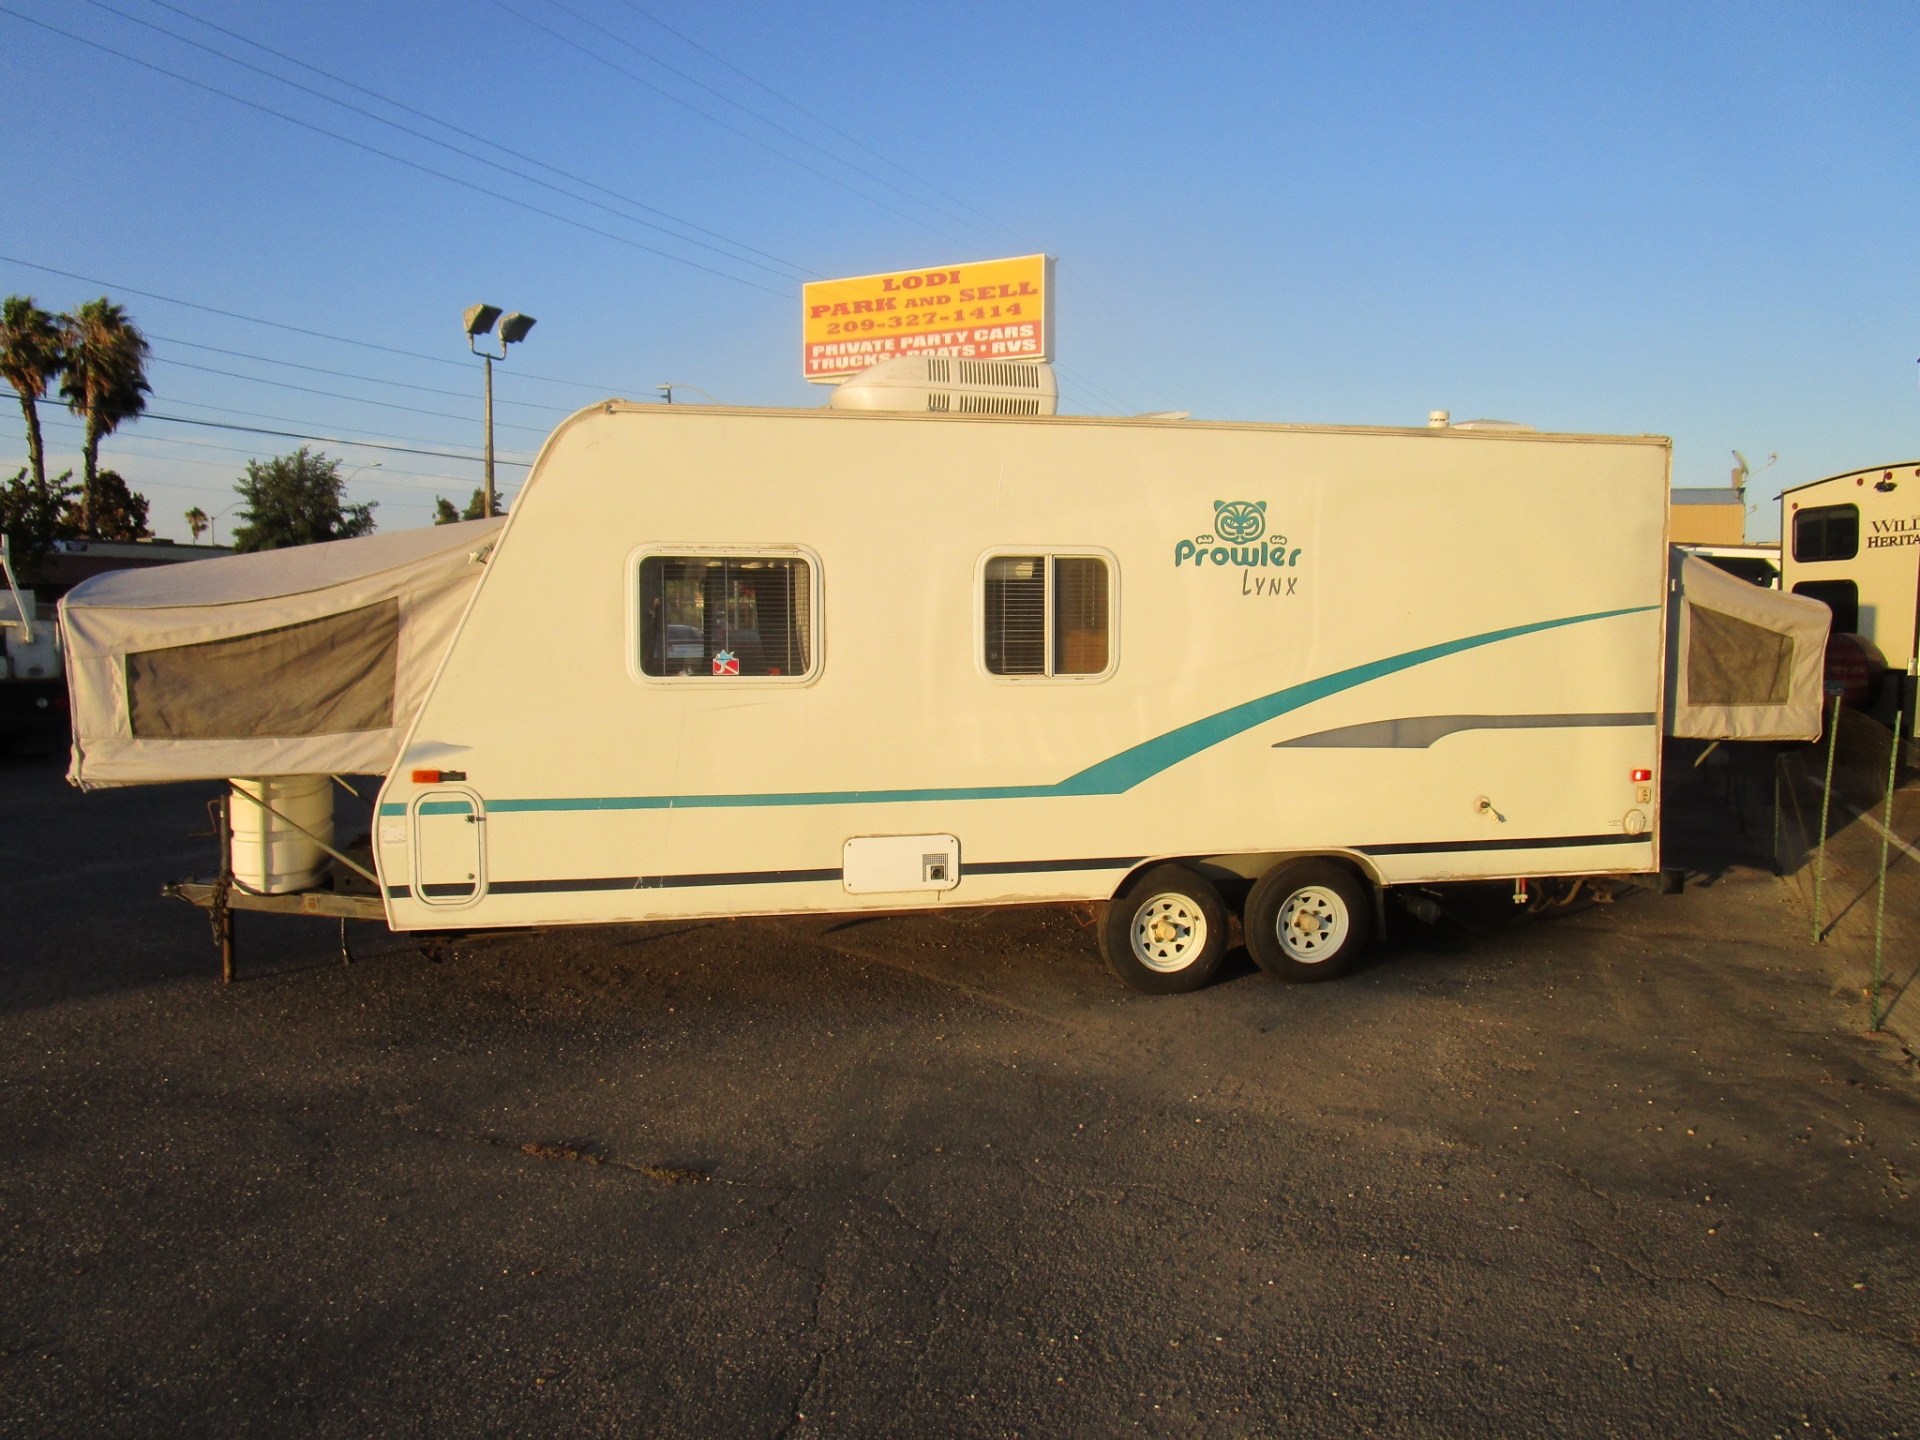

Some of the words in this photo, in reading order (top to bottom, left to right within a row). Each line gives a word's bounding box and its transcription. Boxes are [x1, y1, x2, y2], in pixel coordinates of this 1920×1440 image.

[883, 270, 960, 292] LODI
[811, 297, 897, 319] PARK
[904, 294, 951, 309] AND
[959, 281, 1038, 303] SELL
[827, 302, 1022, 335] 209-327-1414
[812, 338, 895, 358] PRIVATE
[900, 330, 970, 349] PARTY
[974, 324, 1035, 341] CARS
[991, 338, 1037, 354] RVS
[1175, 539, 1302, 567] Prowler
